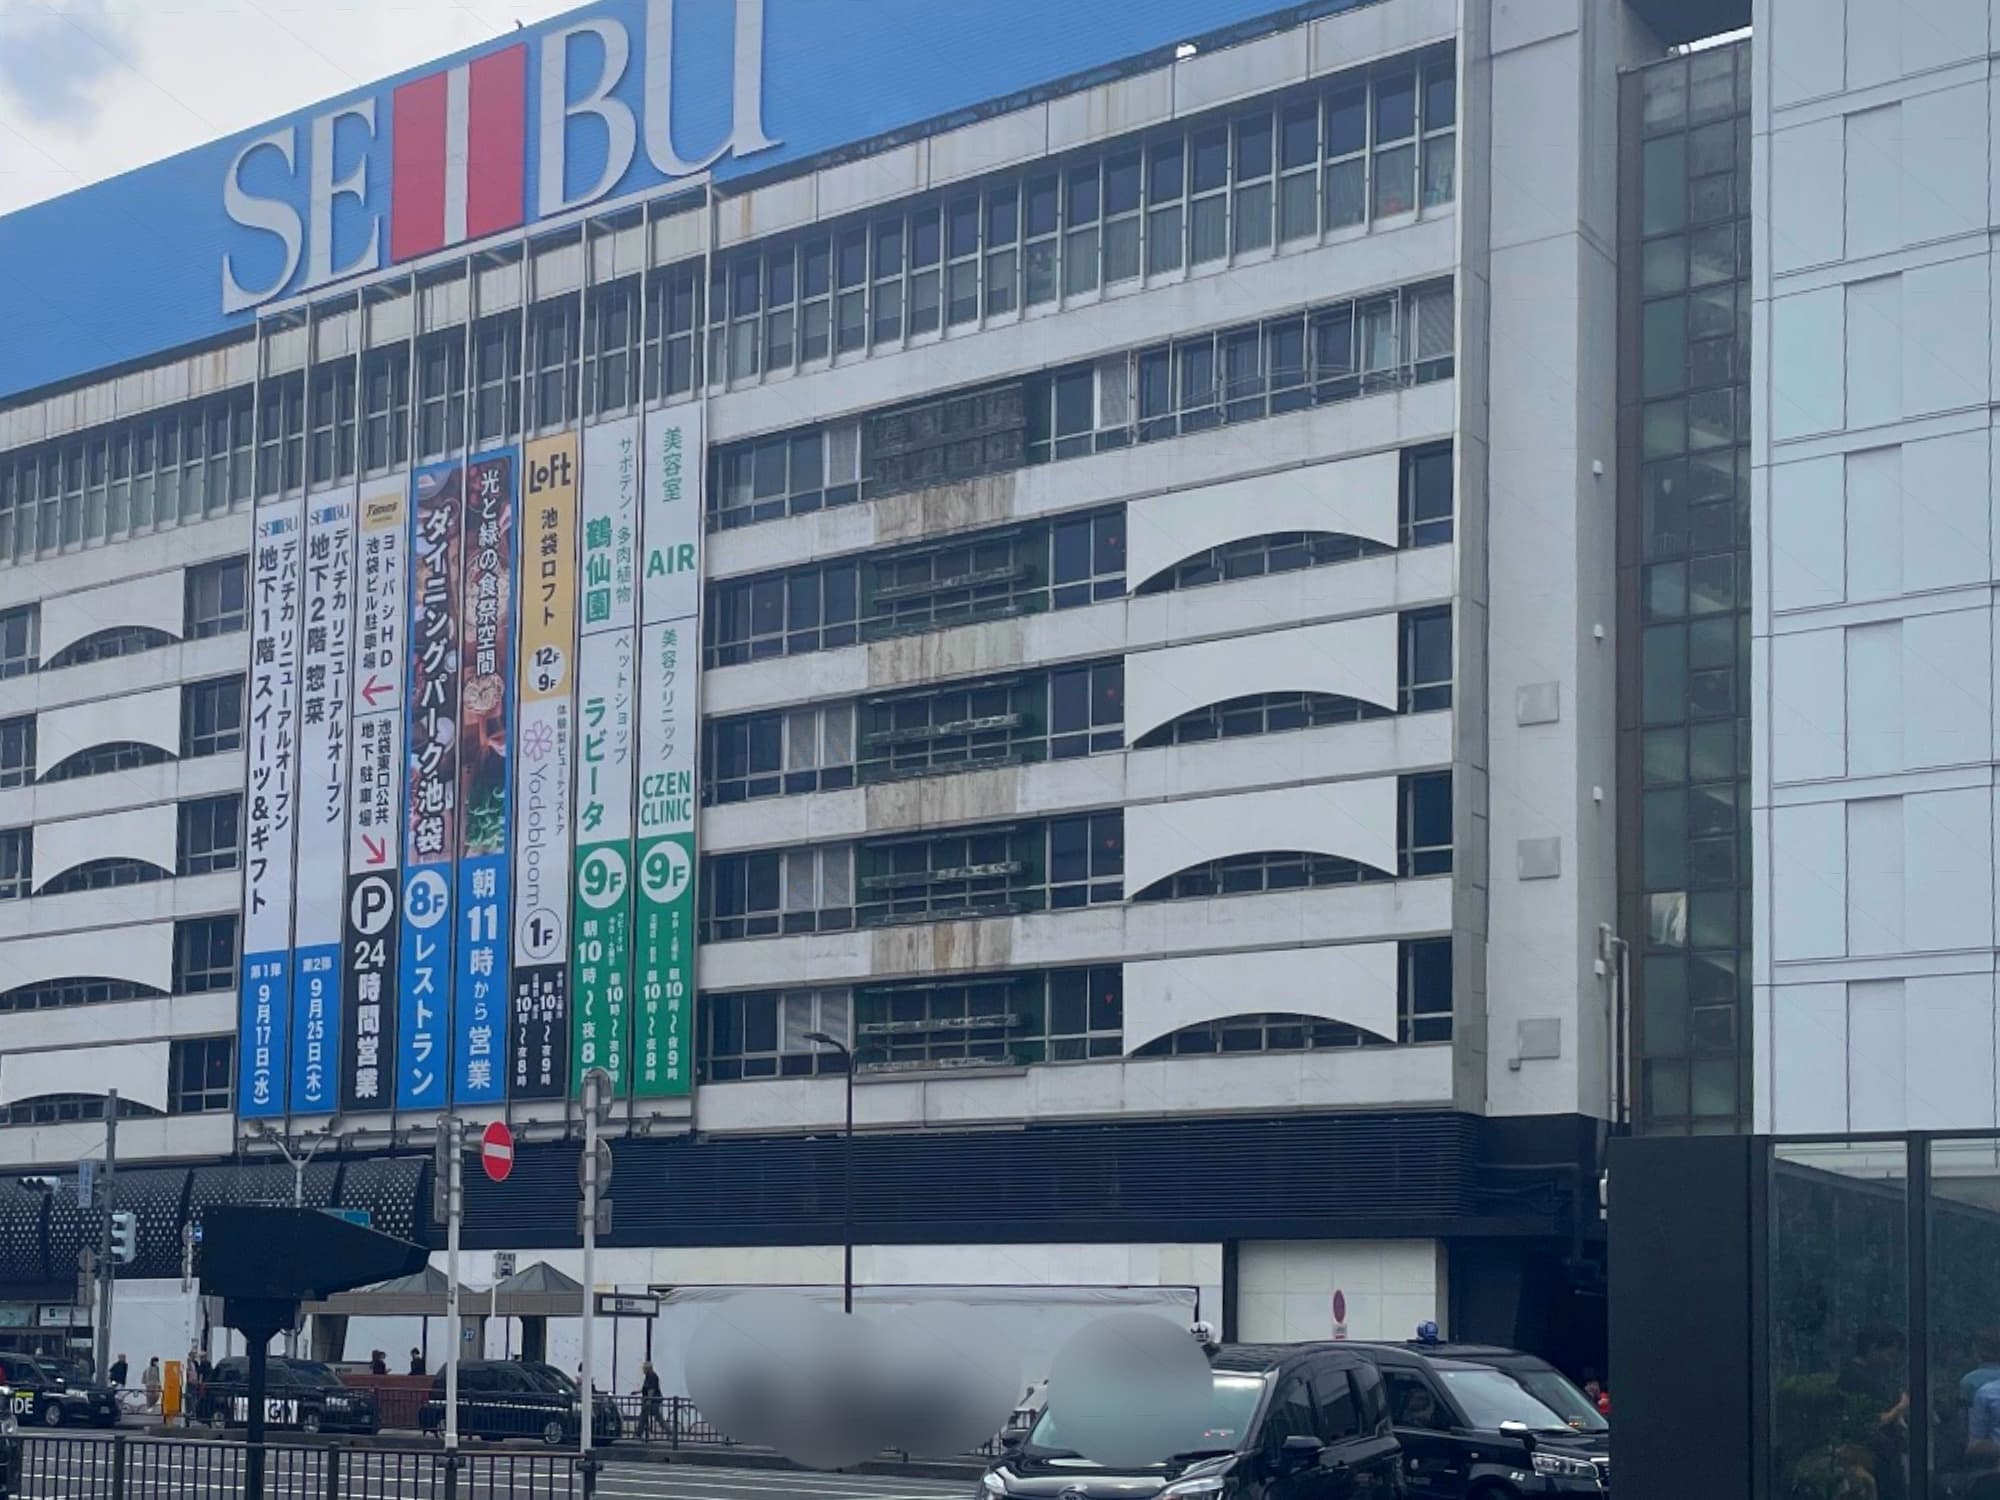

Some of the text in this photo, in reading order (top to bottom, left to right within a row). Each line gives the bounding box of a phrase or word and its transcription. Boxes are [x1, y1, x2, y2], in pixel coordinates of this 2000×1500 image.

[222, 0, 785, 314] SEIBU
[662, 427, 684, 502] 美容室
[380, 535, 395, 668] ヨドバシHD
[476, 469, 500, 675] 光と緑の食祭空間
[540, 509, 559, 627] 池袋ロフト
[585, 515, 612, 624] 鶴仙園
[647, 544, 696, 579] AIR
[415, 507, 451, 852] ダイニングパーク池袋
[536, 647, 560, 667] 12F
[538, 673, 557, 691] 9F
[614, 636, 631, 764] ペットショップ
[660, 628, 678, 760] 美容クリニック
[358, 722, 375, 827] 地下駐車場
[375, 719, 392, 824] 池袋東口公共
[582, 697, 606, 832] ラビータ
[641, 798, 692, 826] CLINIC
[643, 770, 691, 798] CZEN
[525, 763, 548, 907] Yodobloom
[583, 858, 622, 896] 9F
[646, 852, 686, 890] 9F
[360, 886, 386, 928] P
[409, 880, 444, 916] 8F
[530, 918, 553, 948] 1F
[354, 941, 386, 1099] 24時間営業
[411, 935, 435, 1096] レストラン
[467, 868, 496, 1090] 朝11時から営業
